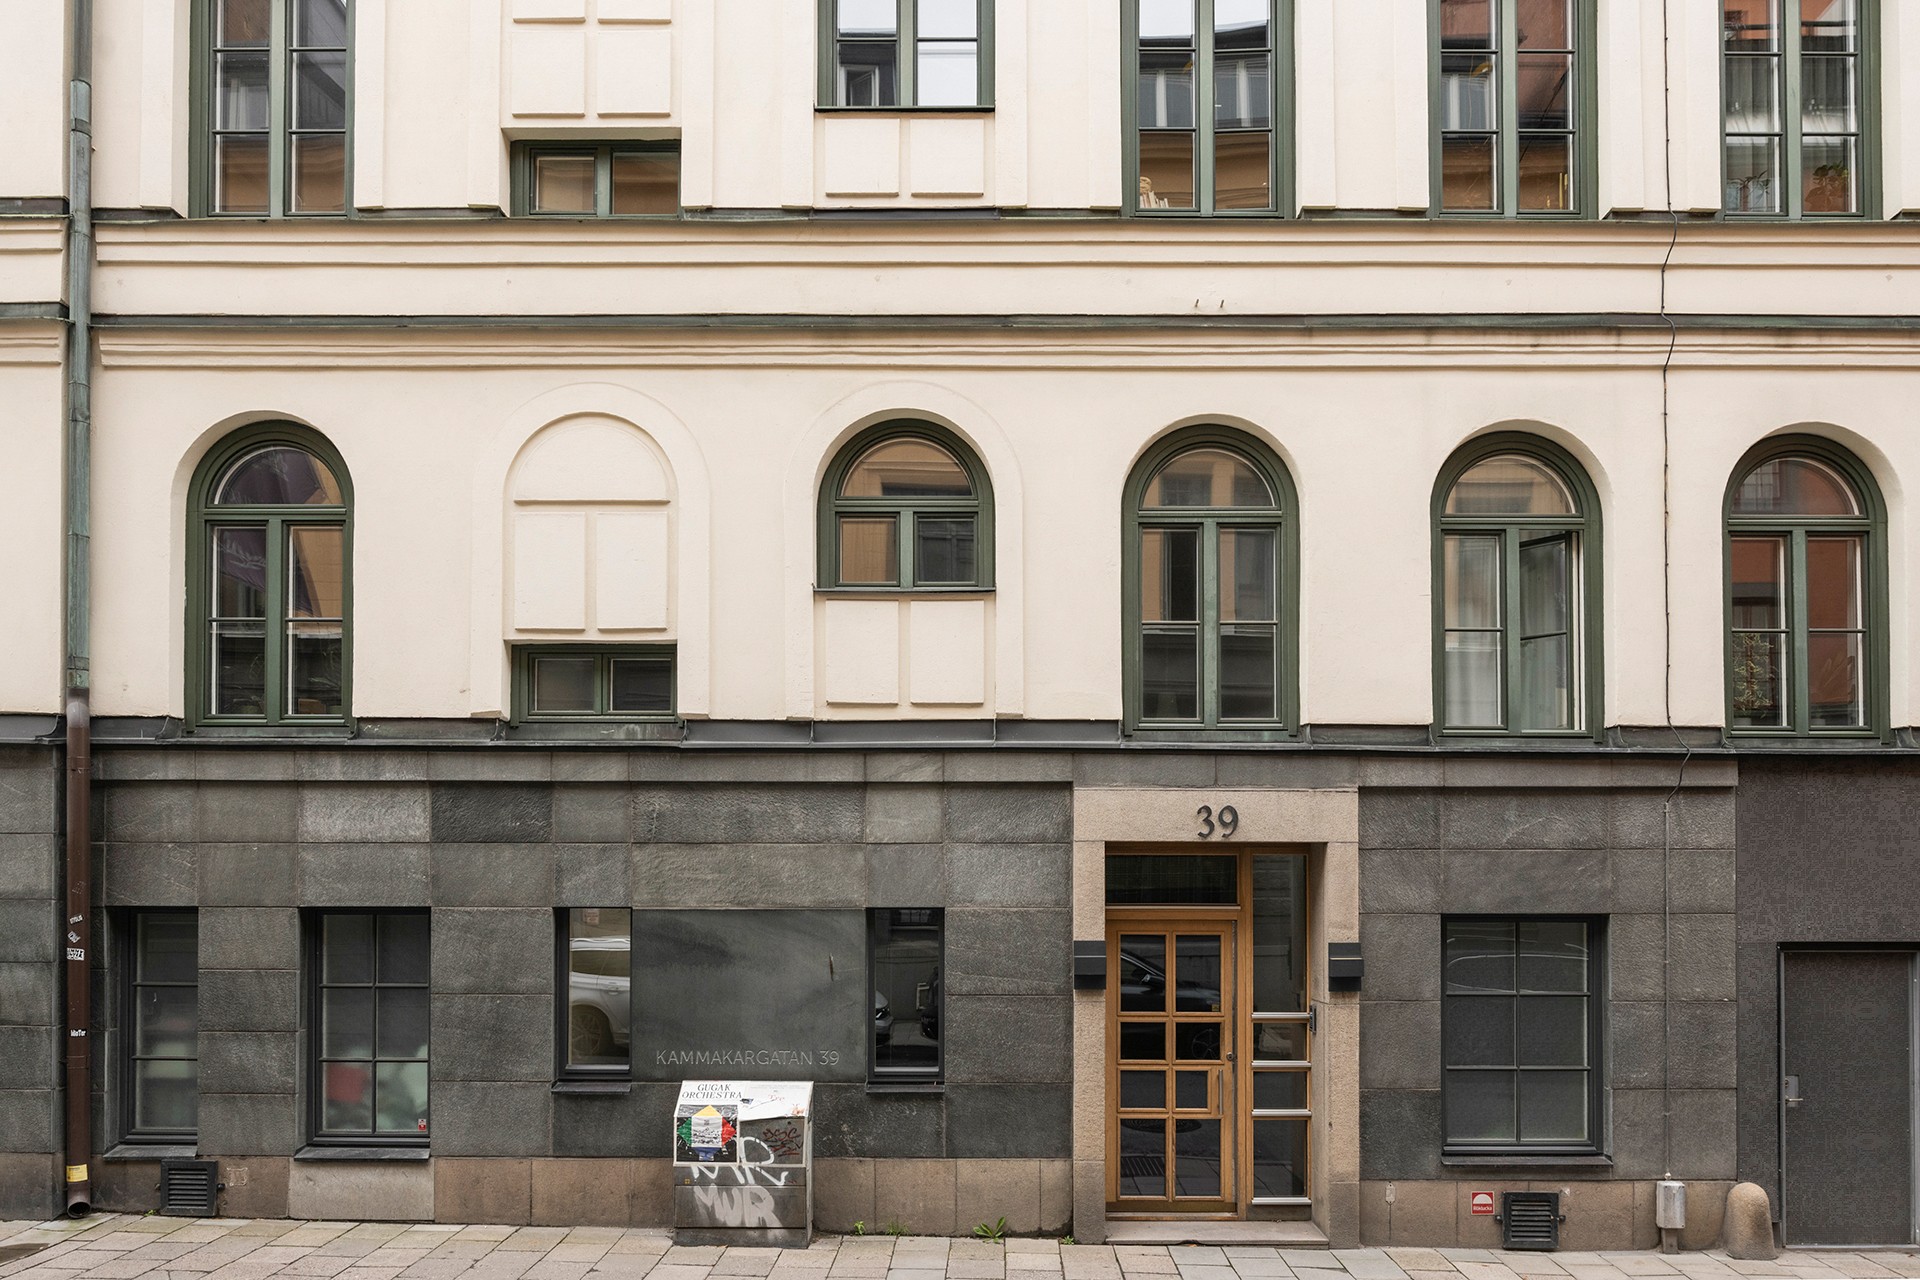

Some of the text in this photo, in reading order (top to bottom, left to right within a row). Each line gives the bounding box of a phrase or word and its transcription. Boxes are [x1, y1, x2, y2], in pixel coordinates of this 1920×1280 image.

[1197, 804, 1239, 838] 39
[656, 1050, 840, 1066] KAMMAKARGATAN 39
[697, 1083, 731, 1092] GUGAK
[681, 1091, 743, 1100] ORCHESTRA
